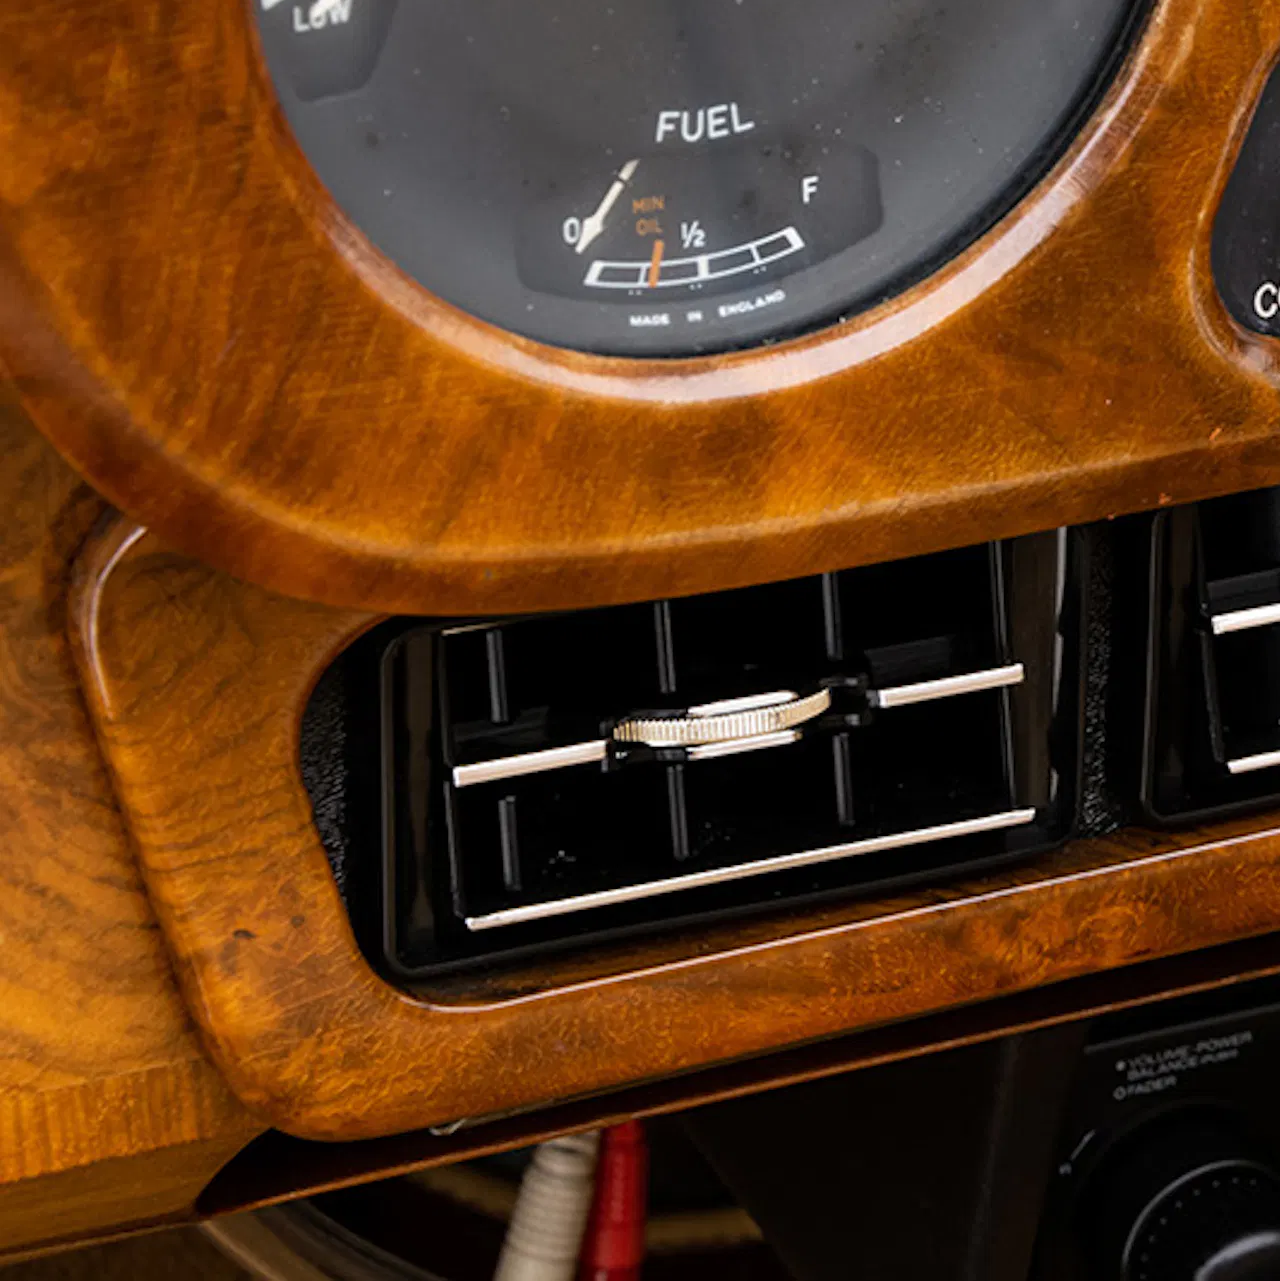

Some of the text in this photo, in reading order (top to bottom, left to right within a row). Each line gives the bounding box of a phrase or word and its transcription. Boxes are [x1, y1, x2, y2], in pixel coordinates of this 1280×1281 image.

[656, 102, 755, 143] FUEL
[802, 176, 819, 204] F
[629, 289, 786, 327] MADE IN ENGLAND
